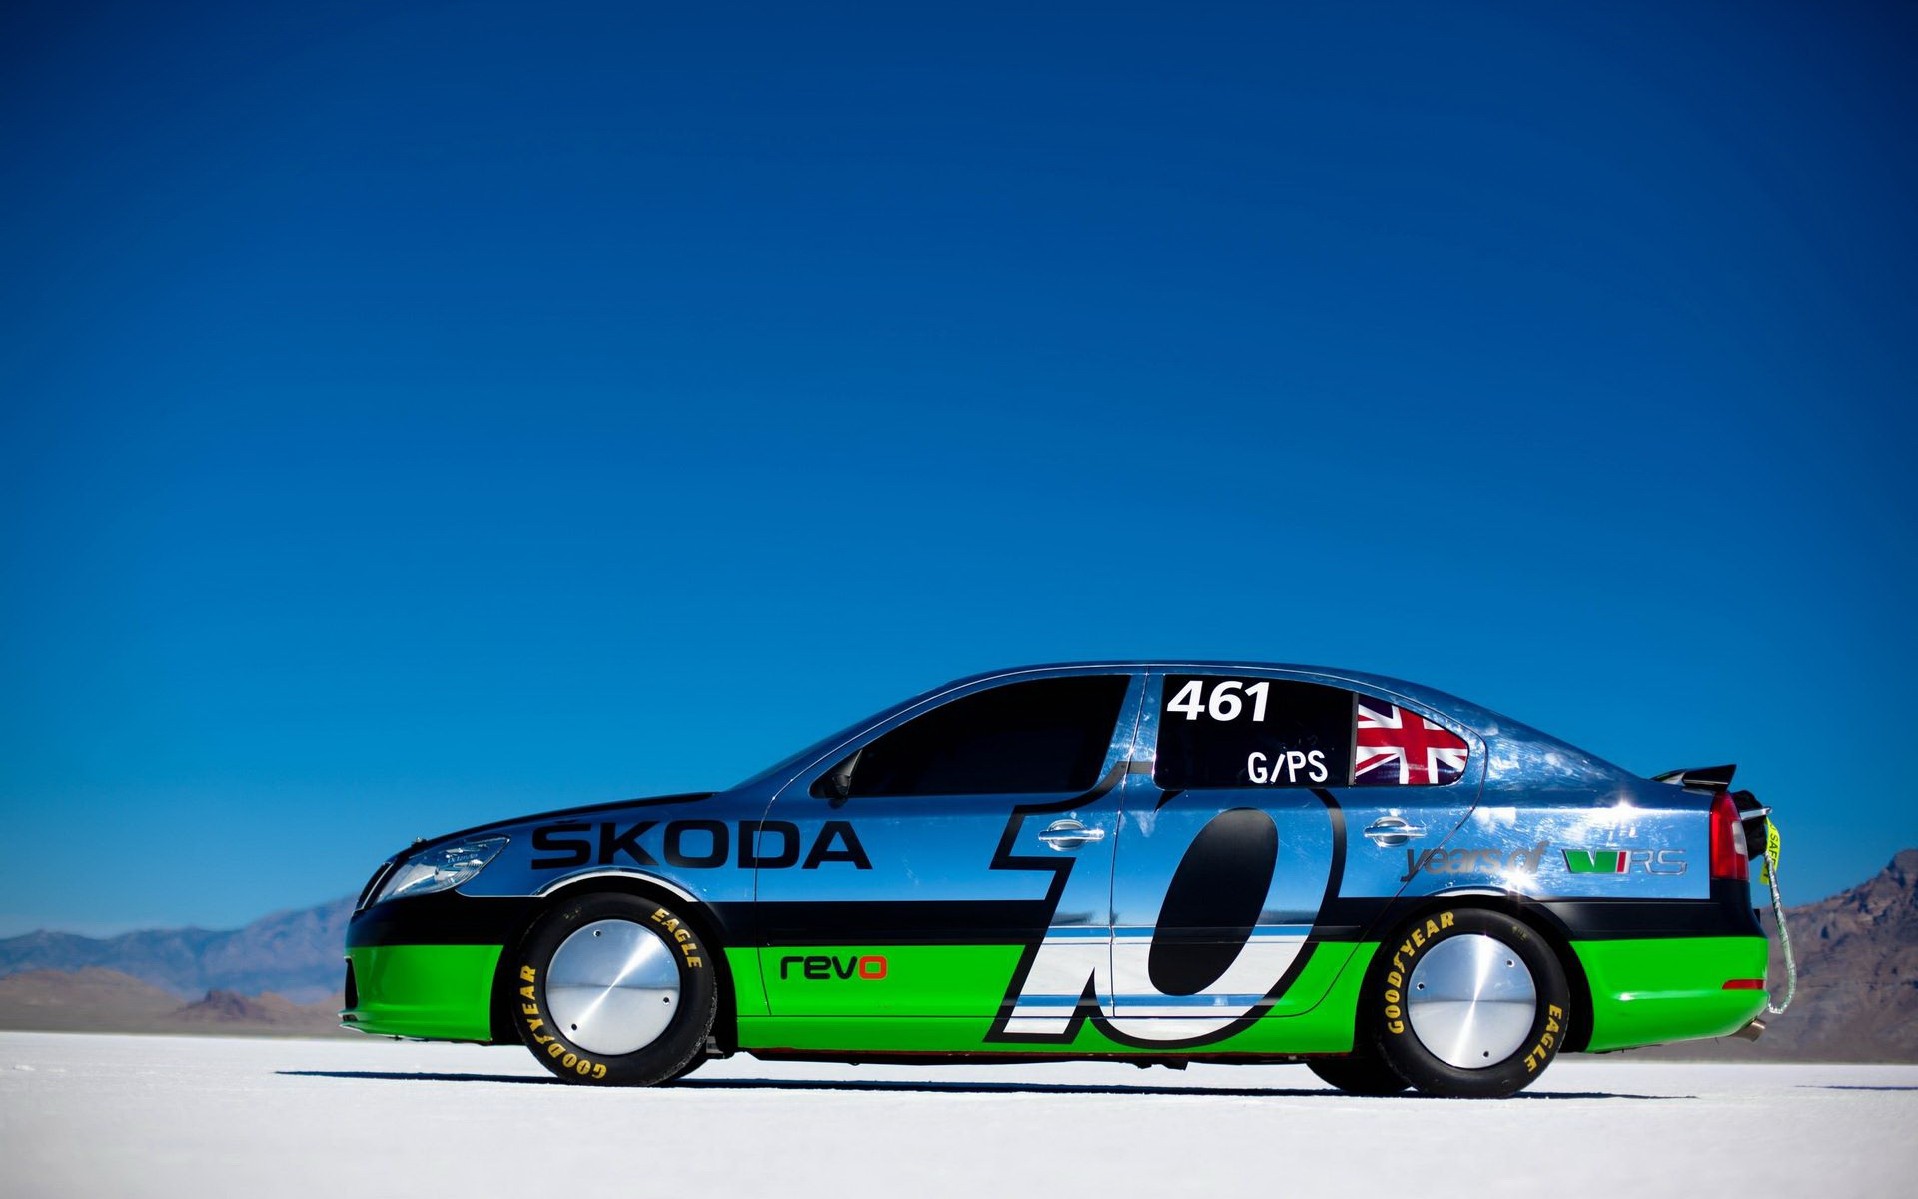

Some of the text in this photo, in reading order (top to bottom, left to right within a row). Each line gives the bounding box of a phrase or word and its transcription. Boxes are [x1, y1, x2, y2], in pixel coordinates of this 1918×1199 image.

[1166, 680, 1270, 722] 461
[1248, 750, 1328, 784] G/PS
[1401, 840, 1549, 883] years of
[982, 760, 1347, 1050] 10
[651, 908, 702, 968] EAGLE
[780, 956, 888, 980] revo
[1385, 911, 1454, 1034] GOODYEAR
[520, 965, 607, 1079] GOODYEAR
[1524, 1003, 1562, 1072] EAGLE
